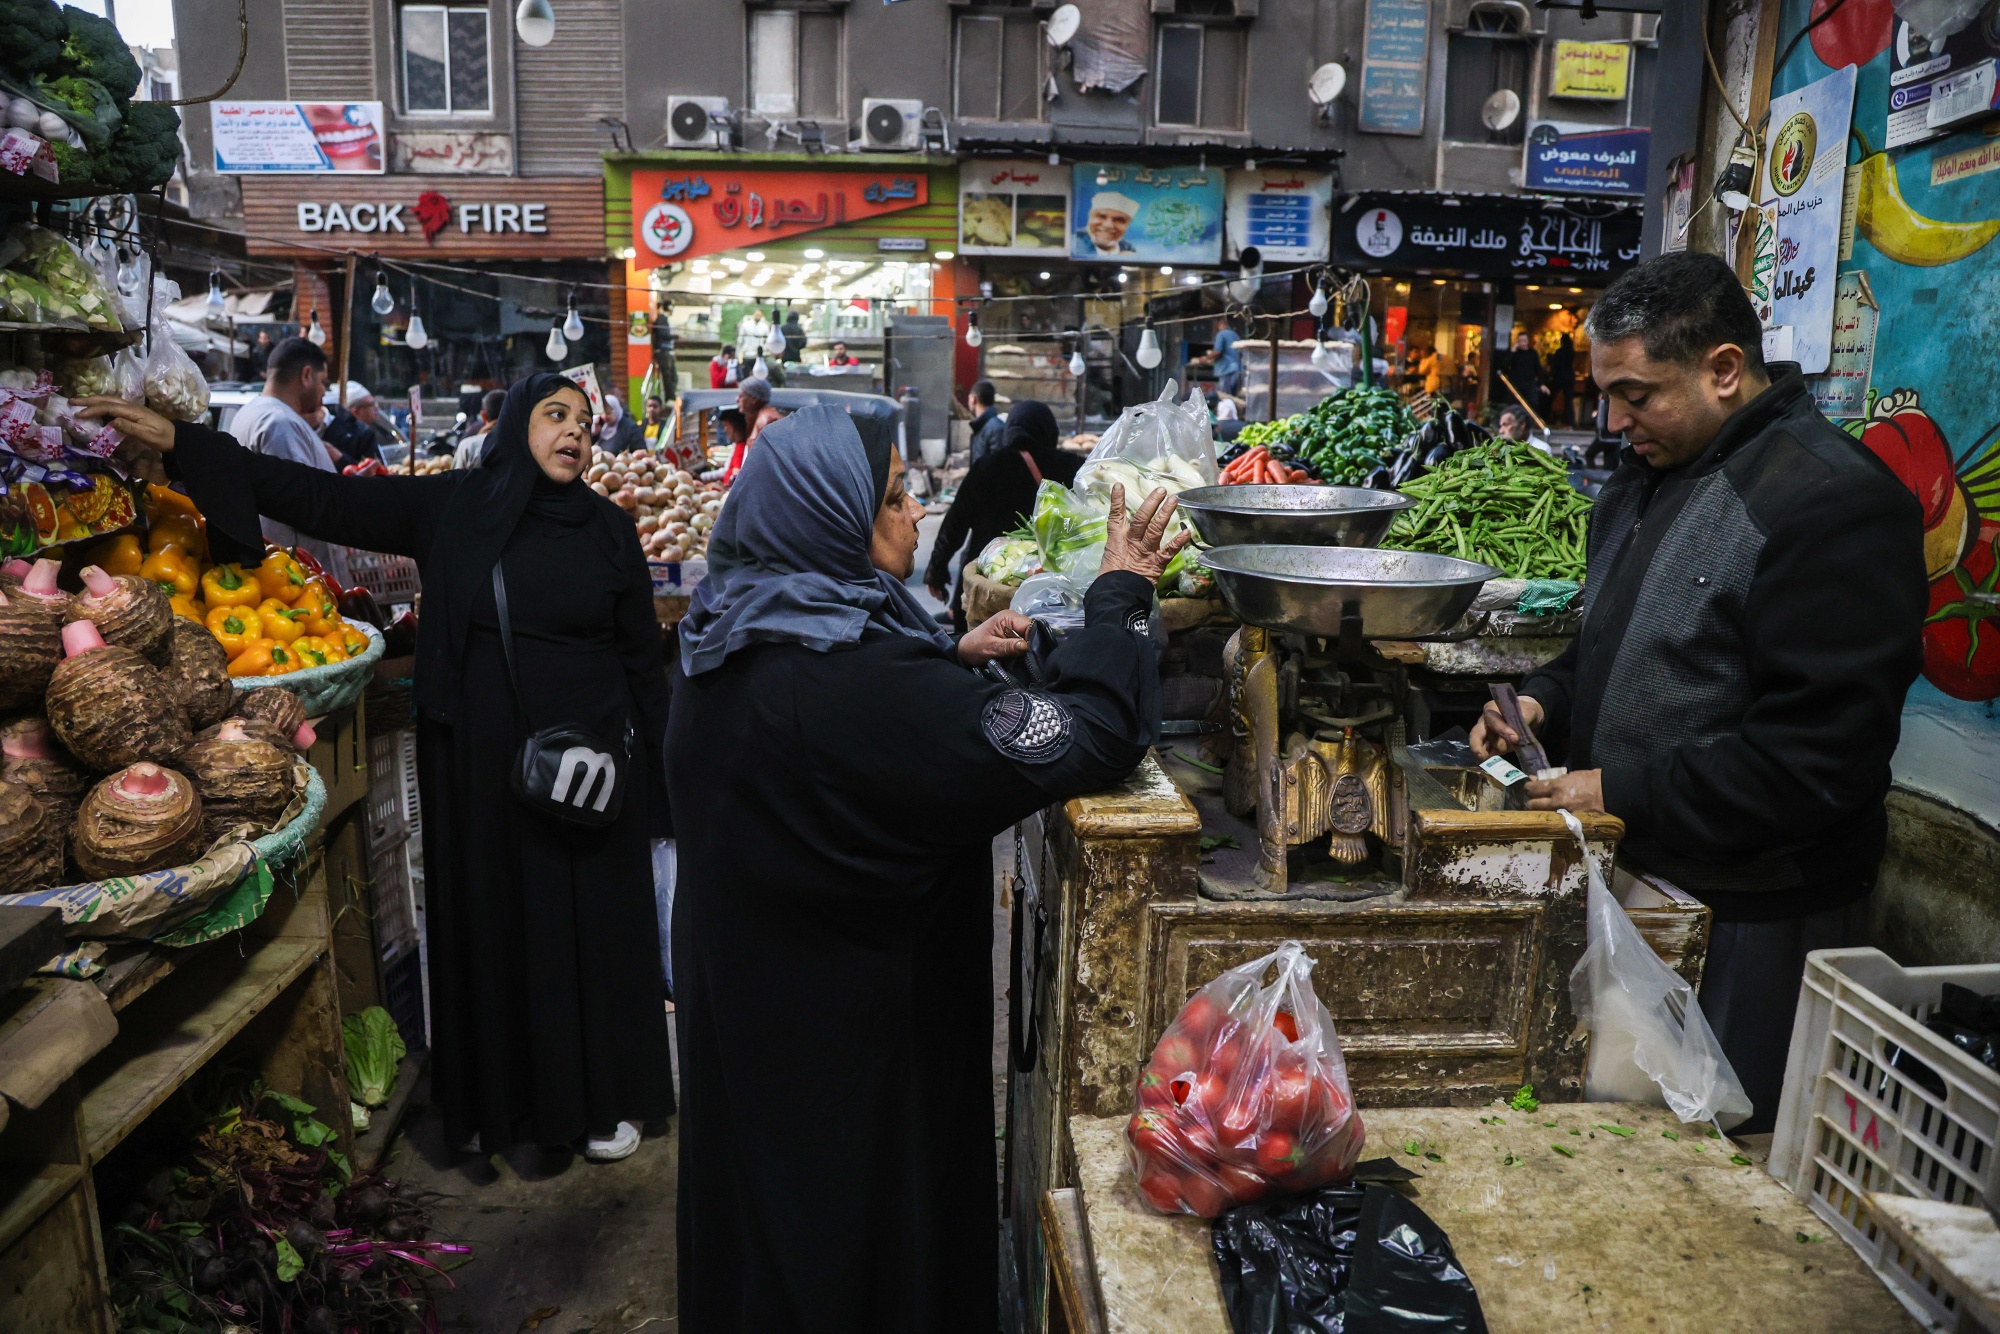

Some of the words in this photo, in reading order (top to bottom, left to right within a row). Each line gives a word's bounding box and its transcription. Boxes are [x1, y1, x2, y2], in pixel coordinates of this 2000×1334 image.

[1976, 70, 1983, 81] ٧
[1939, 83, 1951, 95] ٢٦
[1540, 148, 1591, 163] معوض
[1594, 150, 1636, 166] أشرف
[1957, 154, 1976, 175] ونعم
[1978, 147, 1991, 166] الله
[1937, 158, 1957, 180] الوكيل
[1793, 200, 1805, 215] كل
[1807, 196, 1823, 210] حزب
[298, 203, 406, 232] BACK
[459, 203, 548, 233] FIRE
[1410, 225, 1466, 251] النيفة
[1470, 229, 1507, 250] ملك
[550, 746, 616, 812] m
